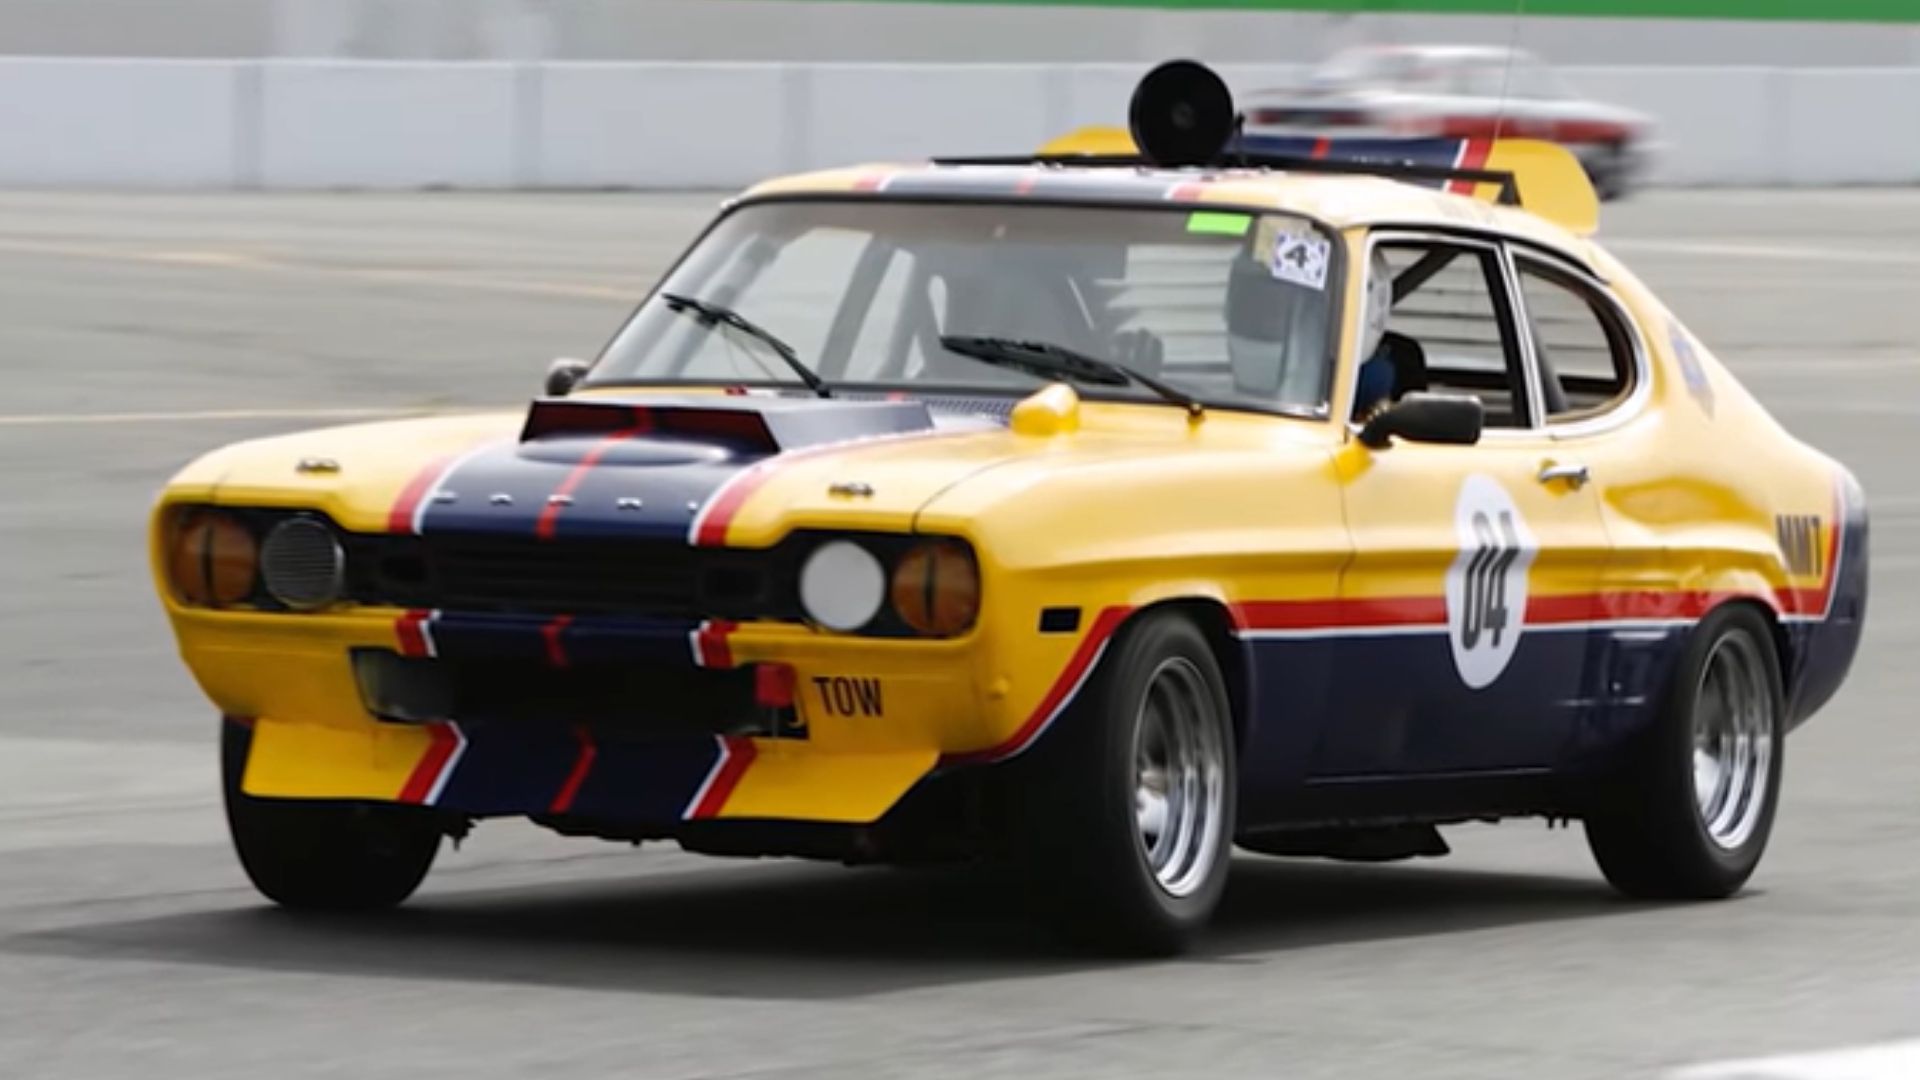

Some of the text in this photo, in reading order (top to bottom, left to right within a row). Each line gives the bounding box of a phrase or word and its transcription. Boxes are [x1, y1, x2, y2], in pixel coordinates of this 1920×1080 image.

[1283, 243, 1310, 269] 4
[1461, 510, 1521, 650] 04
[812, 676, 884, 717] TOW
